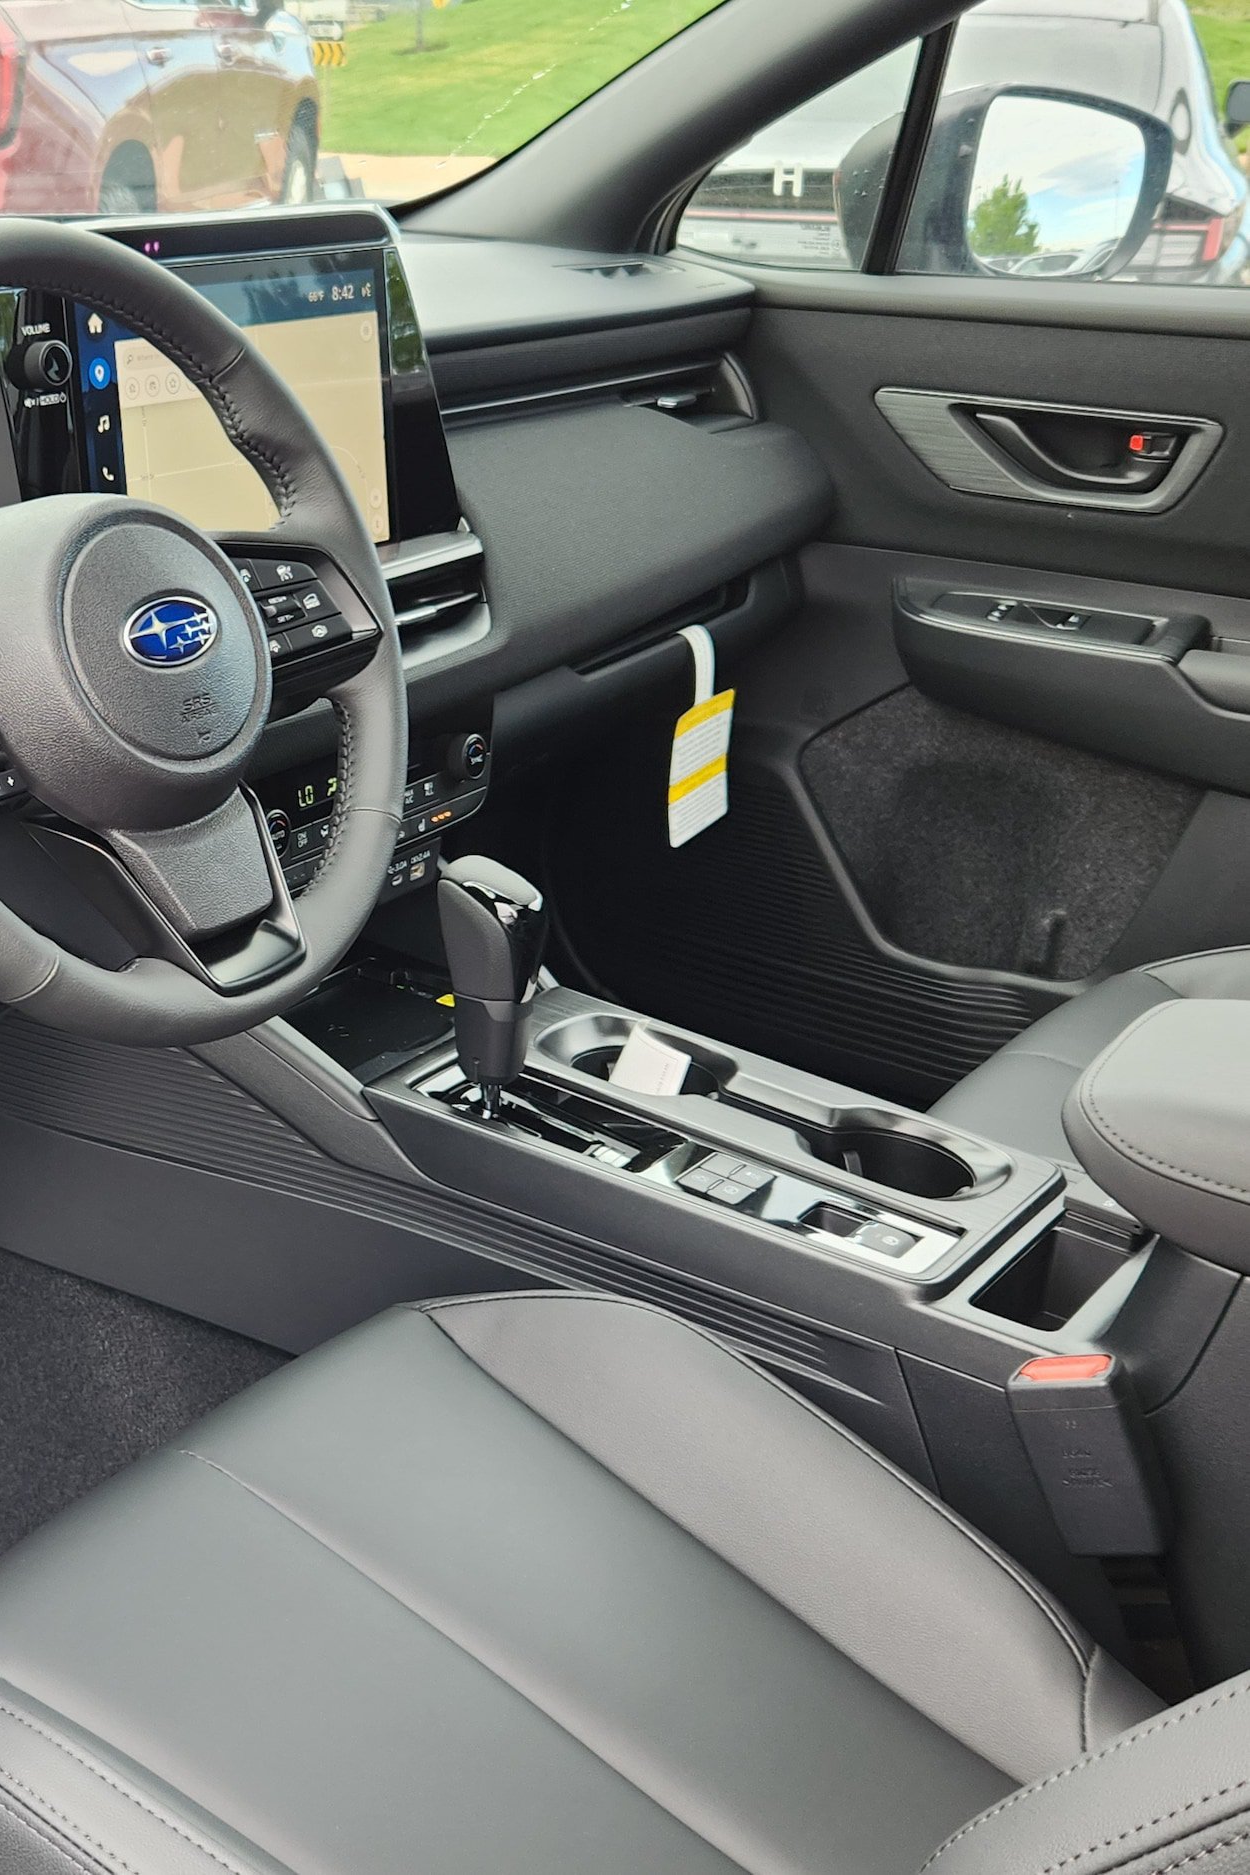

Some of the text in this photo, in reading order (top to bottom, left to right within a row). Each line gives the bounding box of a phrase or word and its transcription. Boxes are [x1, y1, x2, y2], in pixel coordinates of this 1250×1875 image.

[773, 161, 803, 197] H
[332, 283, 354, 301] 8:42
[20, 322, 51, 336] VOLUME
[182, 693, 211, 711] SRS
[298, 785, 313, 807] LO
